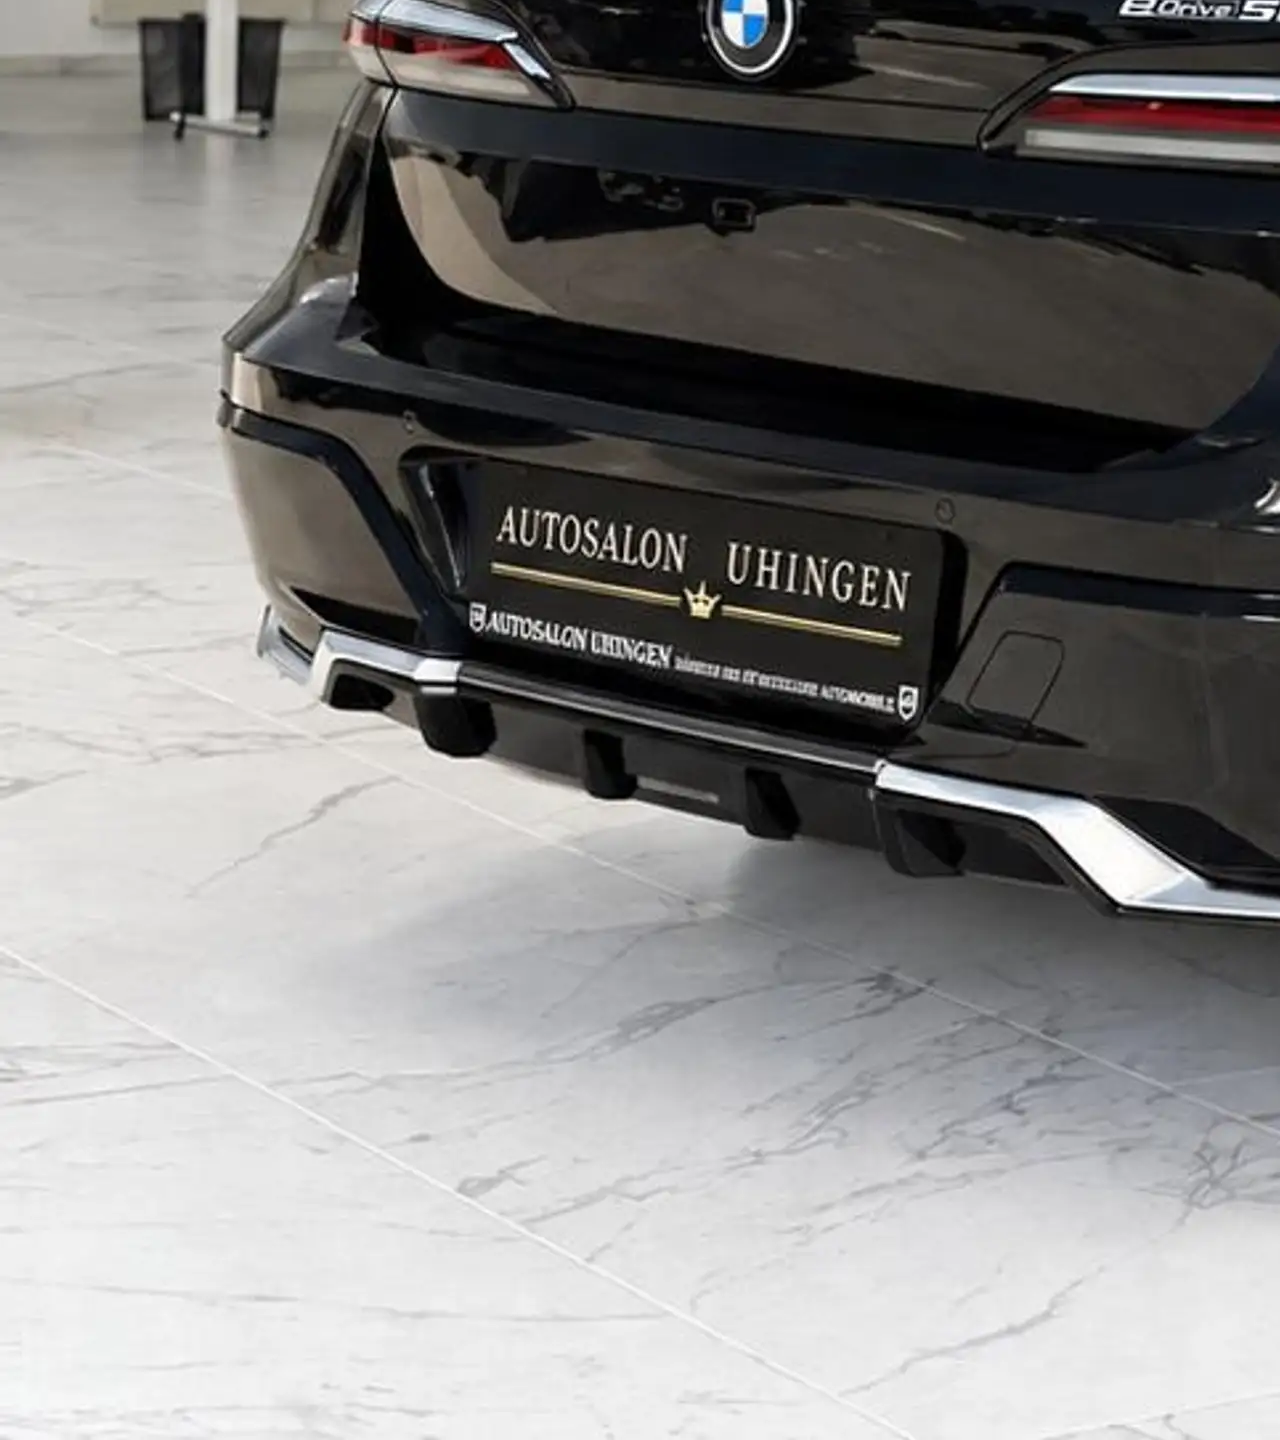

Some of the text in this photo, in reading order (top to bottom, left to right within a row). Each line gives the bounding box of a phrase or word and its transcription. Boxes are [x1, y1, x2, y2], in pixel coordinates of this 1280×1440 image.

[496, 506, 911, 611] AUTOSALON UHINGEN
[485, 610, 588, 652] AUTOSALON
[591, 630, 674, 669] UHINGEN
